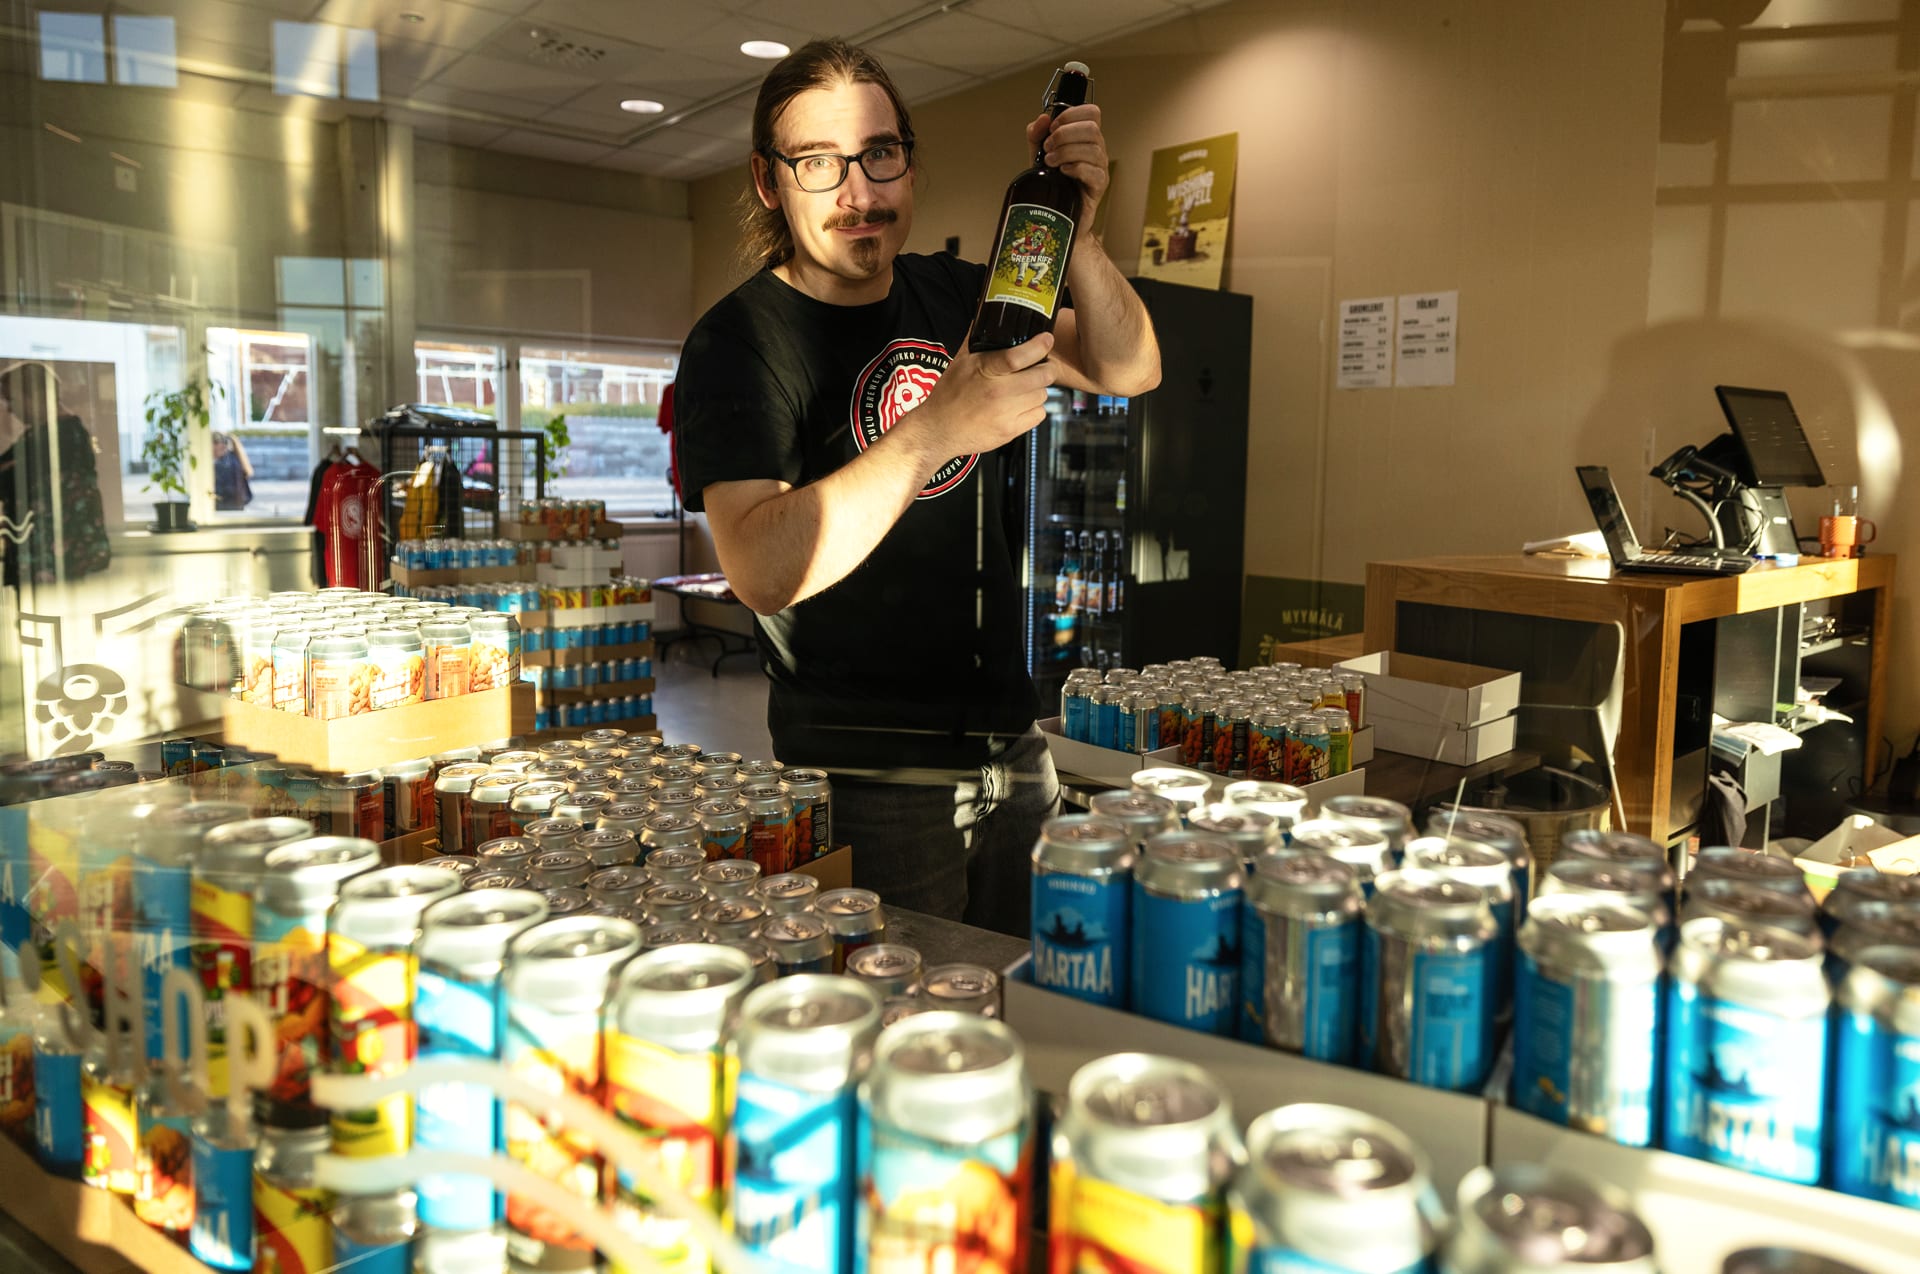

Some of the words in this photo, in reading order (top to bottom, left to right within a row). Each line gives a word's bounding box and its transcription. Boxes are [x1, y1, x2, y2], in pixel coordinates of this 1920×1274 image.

[1011, 253, 1036, 263] GREEN
[920, 353, 949, 369] PANIM
[865, 369, 886, 408] BREWERY
[865, 416, 879, 442] OULU
[1282, 608, 1344, 631] MYYMÄLÄ
[1184, 964, 1240, 1020] HAR
